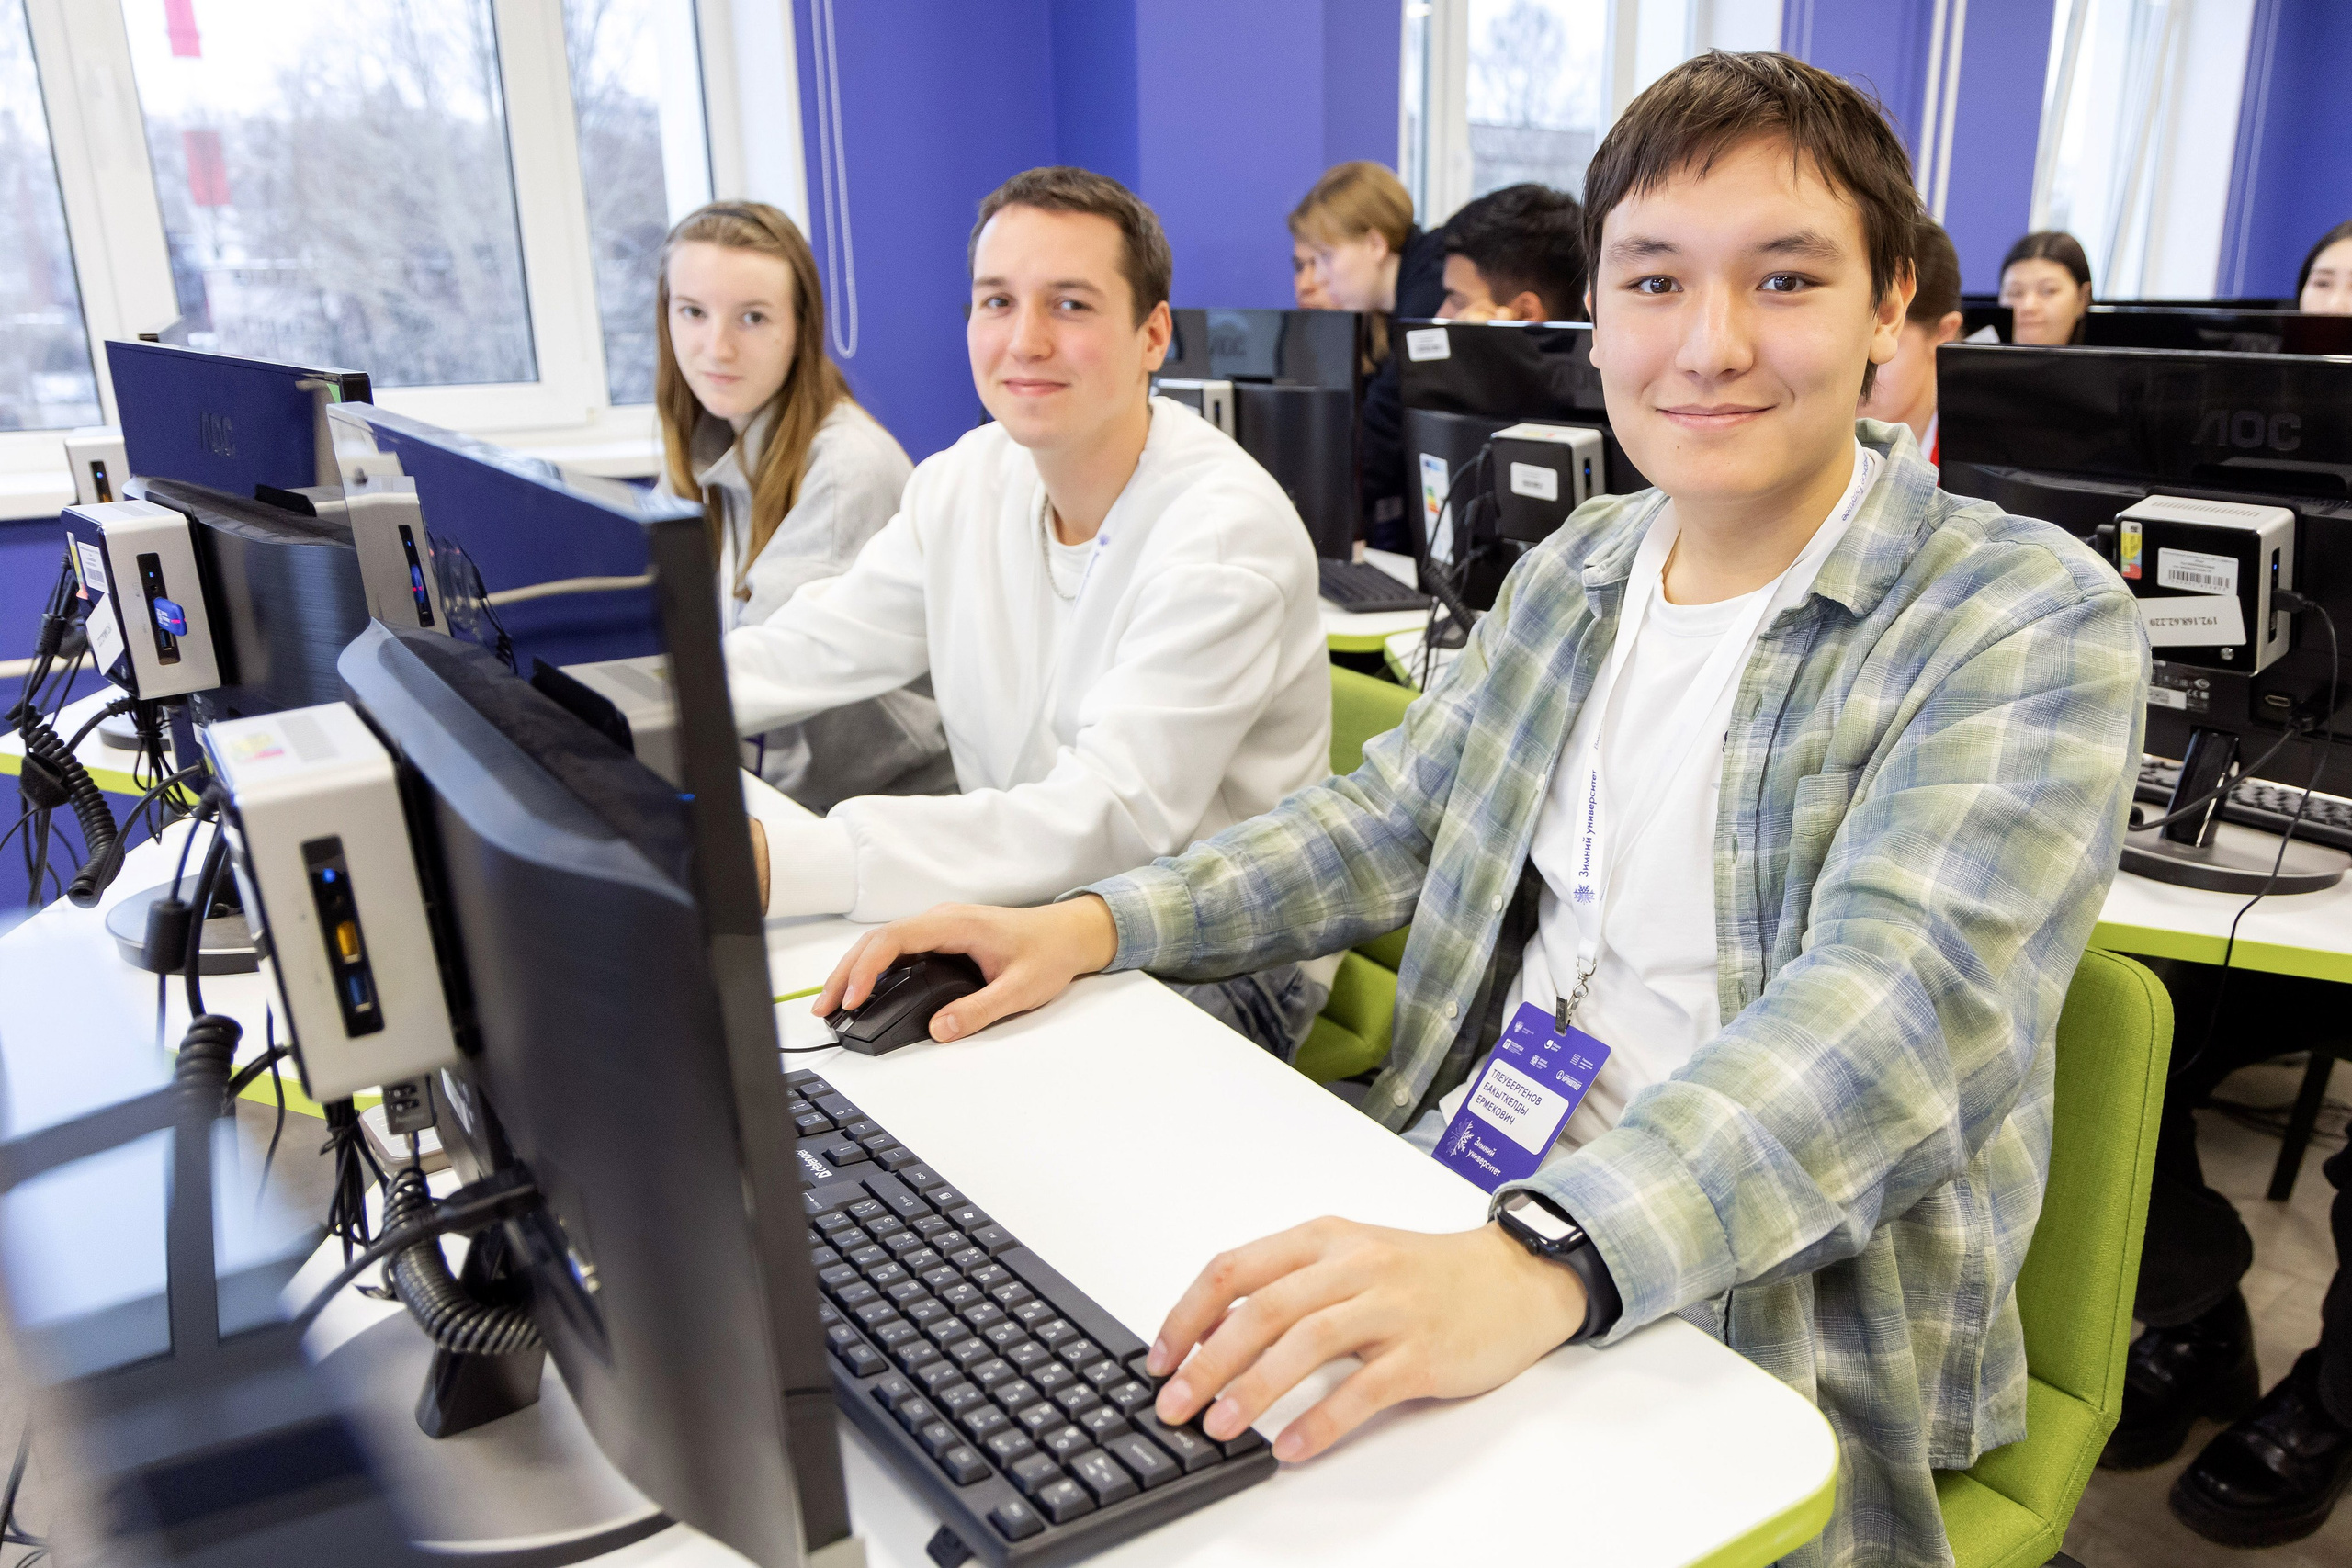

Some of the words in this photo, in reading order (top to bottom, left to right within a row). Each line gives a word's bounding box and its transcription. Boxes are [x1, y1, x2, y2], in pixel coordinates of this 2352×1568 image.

[2150, 616, 2218, 626] 192.168.62.220
[1578, 837, 1592, 877] Зимний
[1587, 770, 1598, 835] университет
[1483, 1082, 1529, 1116] БАКЫТКЕЛДЫ
[1491, 1068, 1543, 1106] ТЛЕУБЕРГЕНОВ
[1475, 1094, 1516, 1126] ЕРМЕКОВИЧ
[1473, 1136, 1497, 1157] Зимний
[1467, 1149, 1501, 1177] университет
